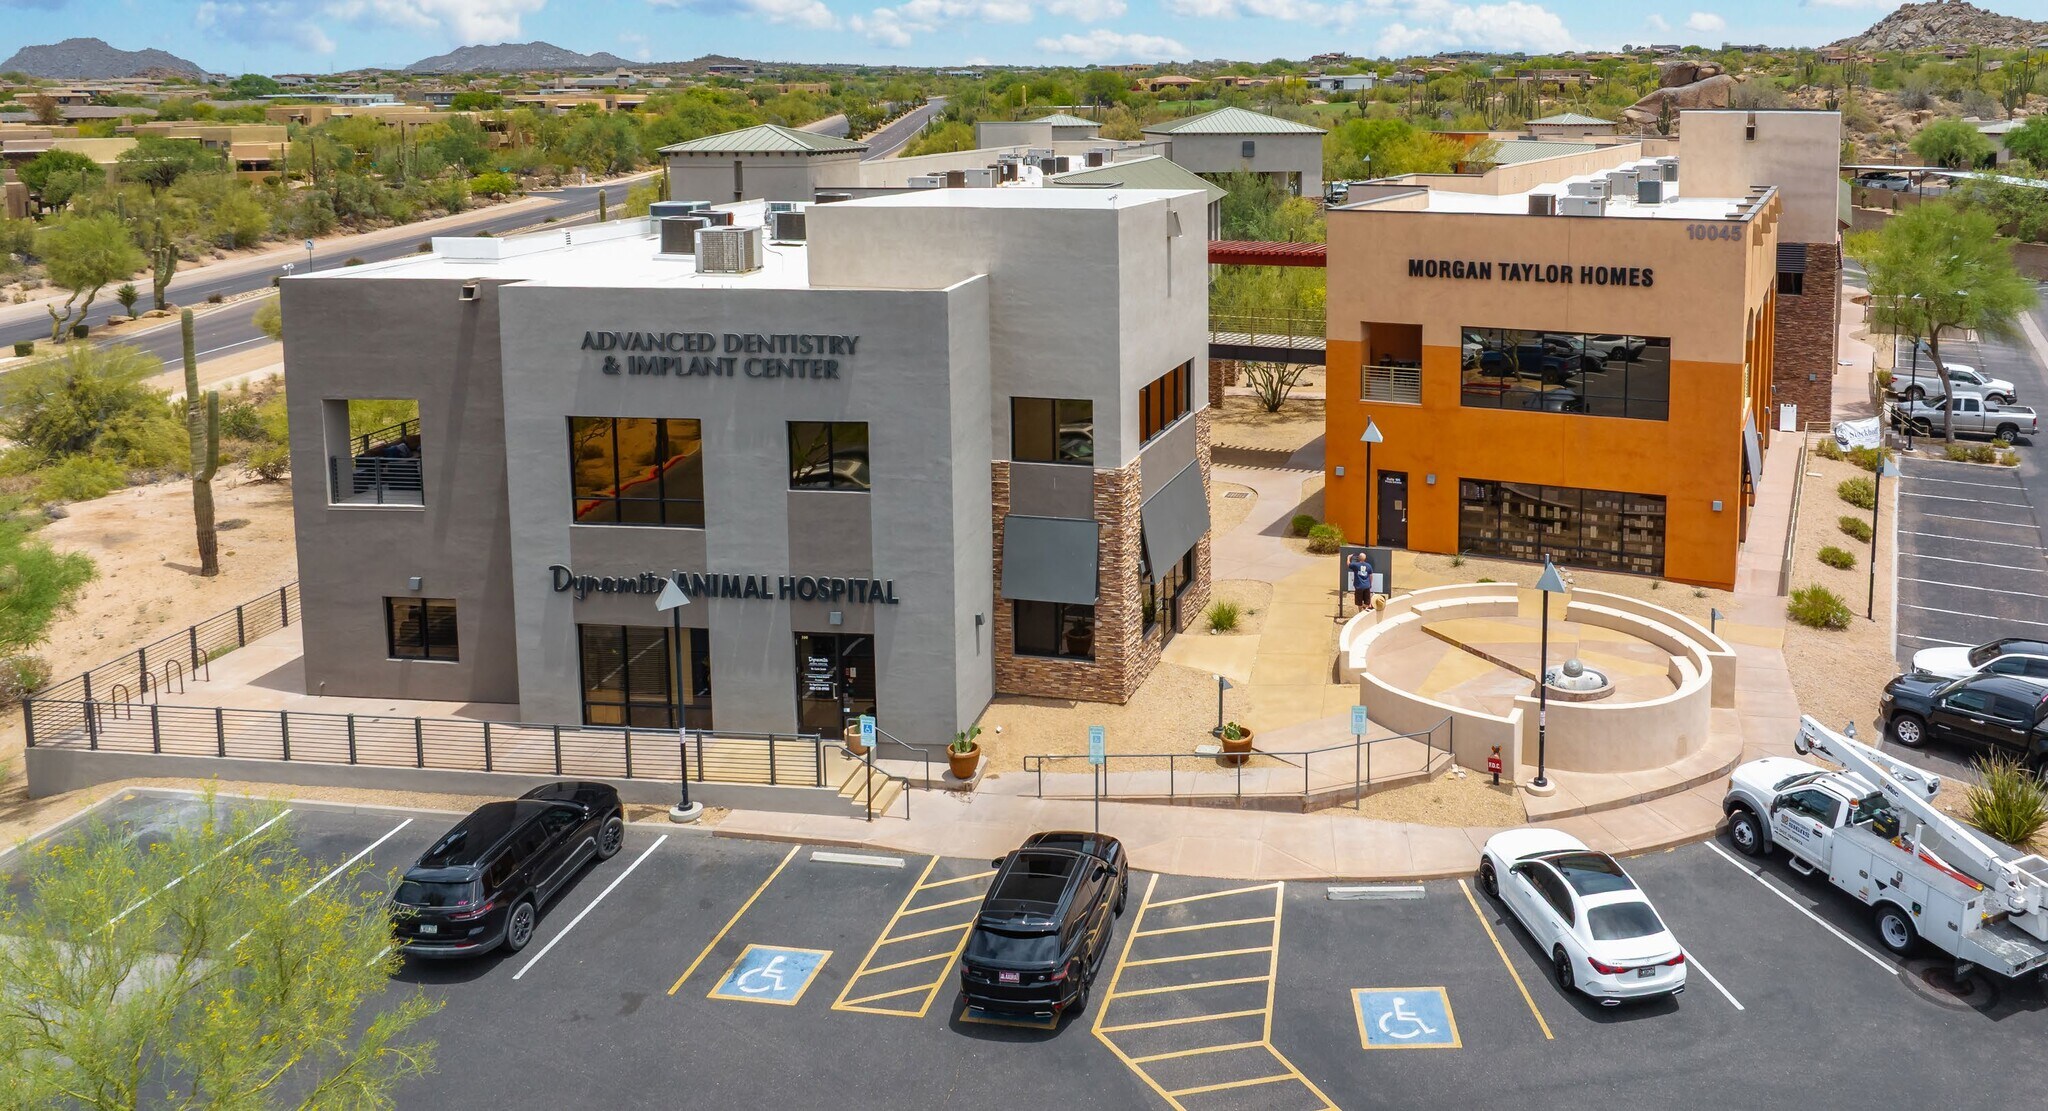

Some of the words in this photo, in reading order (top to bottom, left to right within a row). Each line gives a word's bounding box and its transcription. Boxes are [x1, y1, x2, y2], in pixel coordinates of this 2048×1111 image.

[1686, 224, 1742, 241] 10045
[1408, 259, 1492, 280] MORGAN
[1498, 262, 1573, 284] TAYLOR
[1580, 265, 1654, 287] HOMES
[580, 330, 716, 352] ADVANCED
[723, 333, 861, 355] DENTISTRY
[602, 355, 621, 376] &
[627, 355, 738, 377] IMPLANT
[744, 357, 841, 380] CENTER
[676, 571, 774, 600] ANIMAL
[778, 574, 900, 605] HOSPITAL
